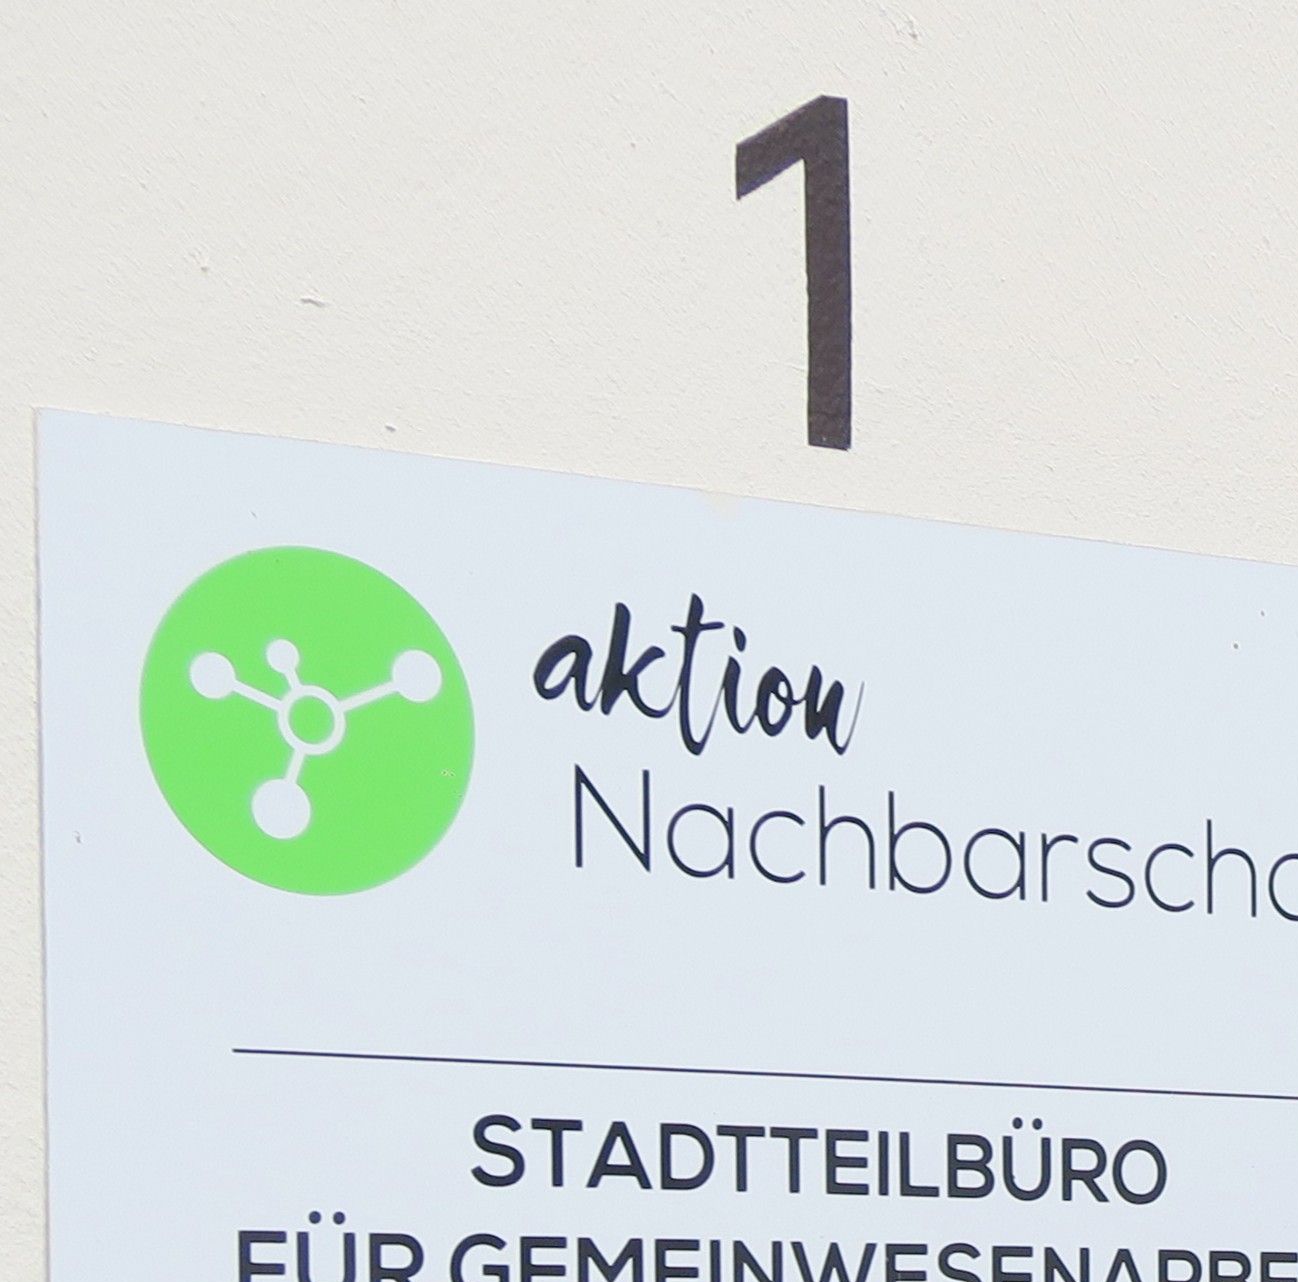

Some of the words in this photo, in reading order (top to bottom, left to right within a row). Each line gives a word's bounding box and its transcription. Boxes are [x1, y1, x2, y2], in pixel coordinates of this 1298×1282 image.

[735, 94, 852, 452] 1
[533, 593, 865, 755] aktion
[471, 1114, 1168, 1206] STADTTEILBÜRO
